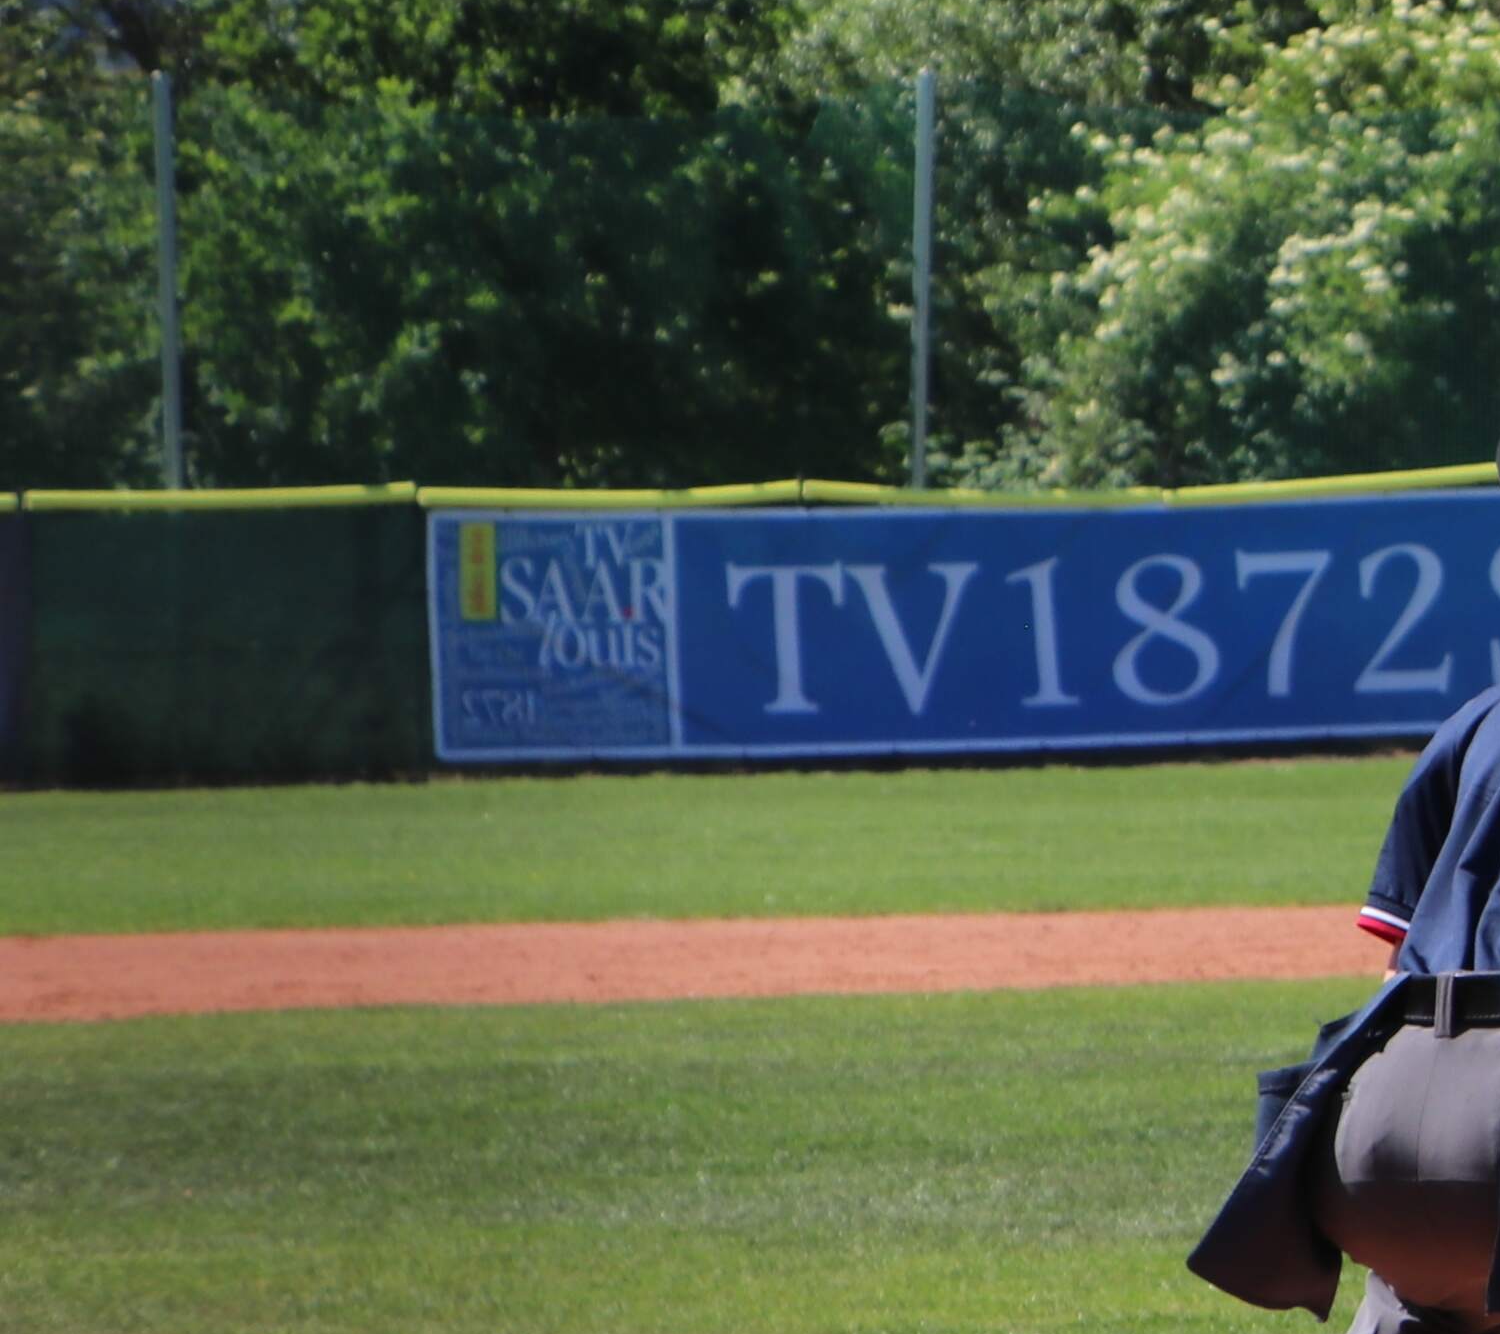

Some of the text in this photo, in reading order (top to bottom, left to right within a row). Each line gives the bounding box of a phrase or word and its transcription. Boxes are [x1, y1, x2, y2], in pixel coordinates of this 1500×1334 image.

[574, 523, 634, 569] TV
[500, 555, 670, 625] SAAR
[537, 610, 662, 669] louis
